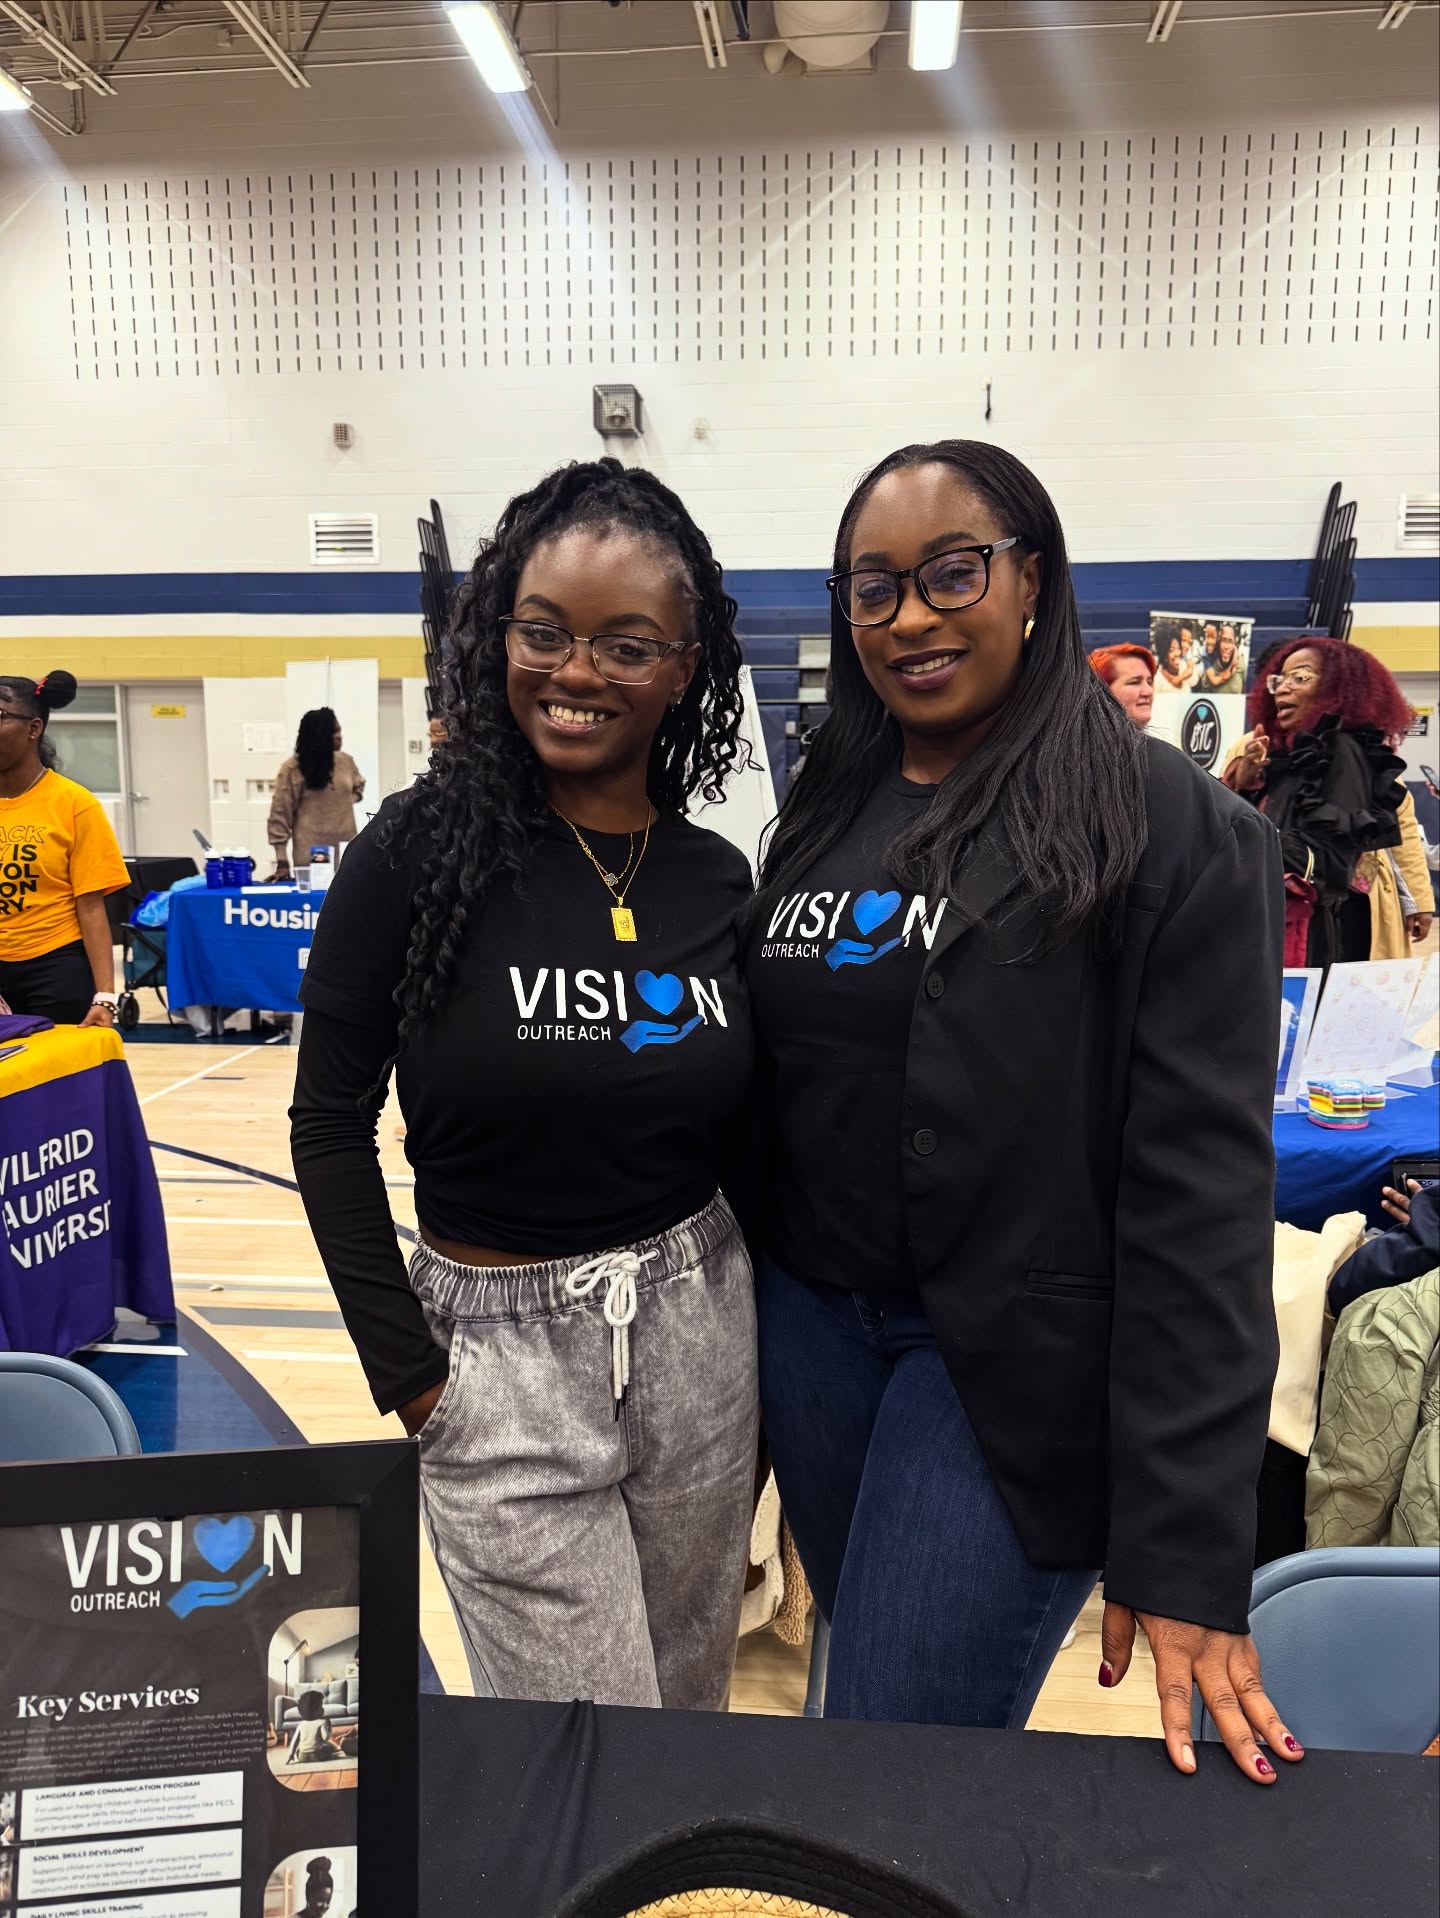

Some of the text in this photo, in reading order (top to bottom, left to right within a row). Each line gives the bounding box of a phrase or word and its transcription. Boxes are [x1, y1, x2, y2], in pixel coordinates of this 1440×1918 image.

[12, 843, 38, 862] IS
[0, 863, 40, 880] OL
[0, 879, 38, 899] ON
[761, 943, 820, 959] OUTREACH
[517, 1024, 612, 1041] OUTREACH
[10, 1199, 112, 1269] NIVERSI
[70, 1590, 161, 1613] OUTREACH
[16, 1685, 200, 1722] Key Services
[79, 1789, 96, 1797] AND
[97, 1785, 161, 1796] COMMUNICATION
[163, 1781, 200, 1790] PROGRAM
[62, 1850, 87, 1859] SKILLS
[88, 1846, 144, 1857] DEVELOPMENT
[82, 1906, 107, 1915] SKILLS
[108, 1903, 144, 1913] TRAINING
